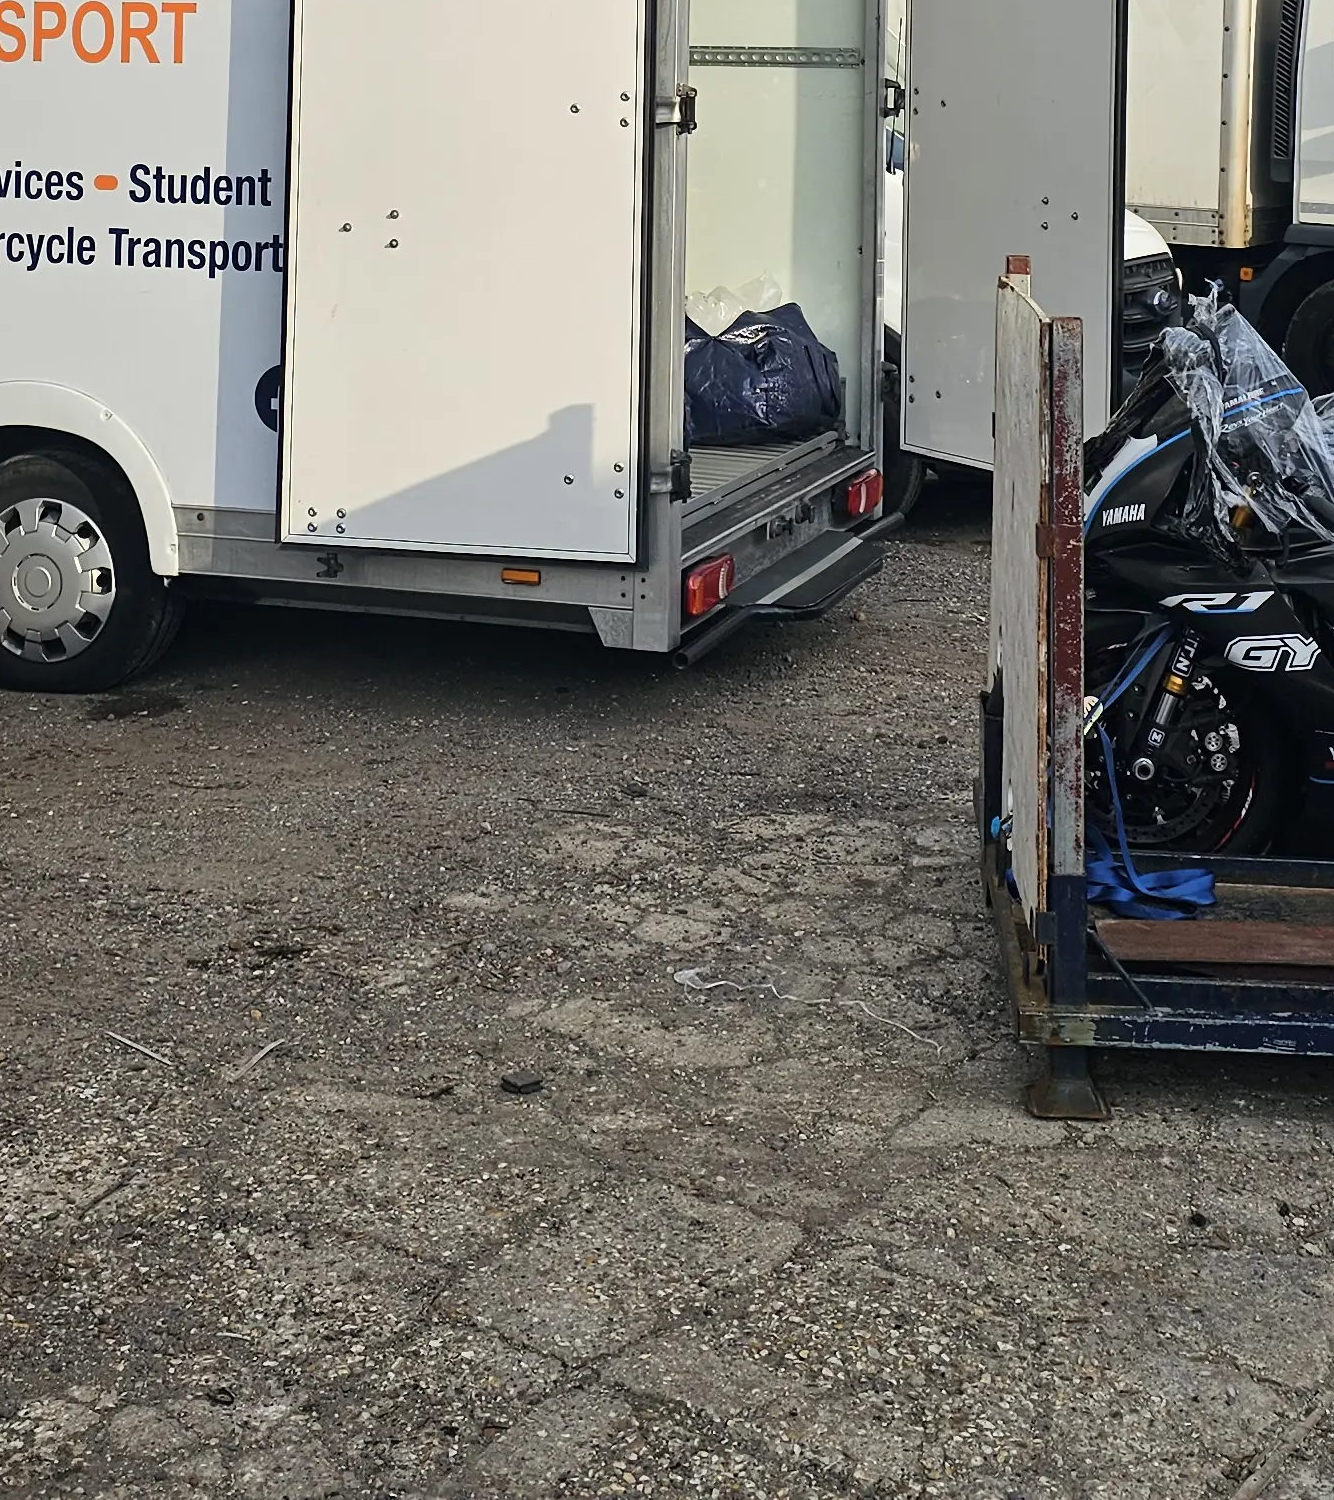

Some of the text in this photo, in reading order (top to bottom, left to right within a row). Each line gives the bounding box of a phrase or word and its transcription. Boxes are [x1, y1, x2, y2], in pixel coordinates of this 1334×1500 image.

[128, 163, 272, 207] Student
[108, 227, 284, 279] Transport
[1101, 503, 1146, 527] YAMAHA
[1158, 590, 1275, 614] R1
